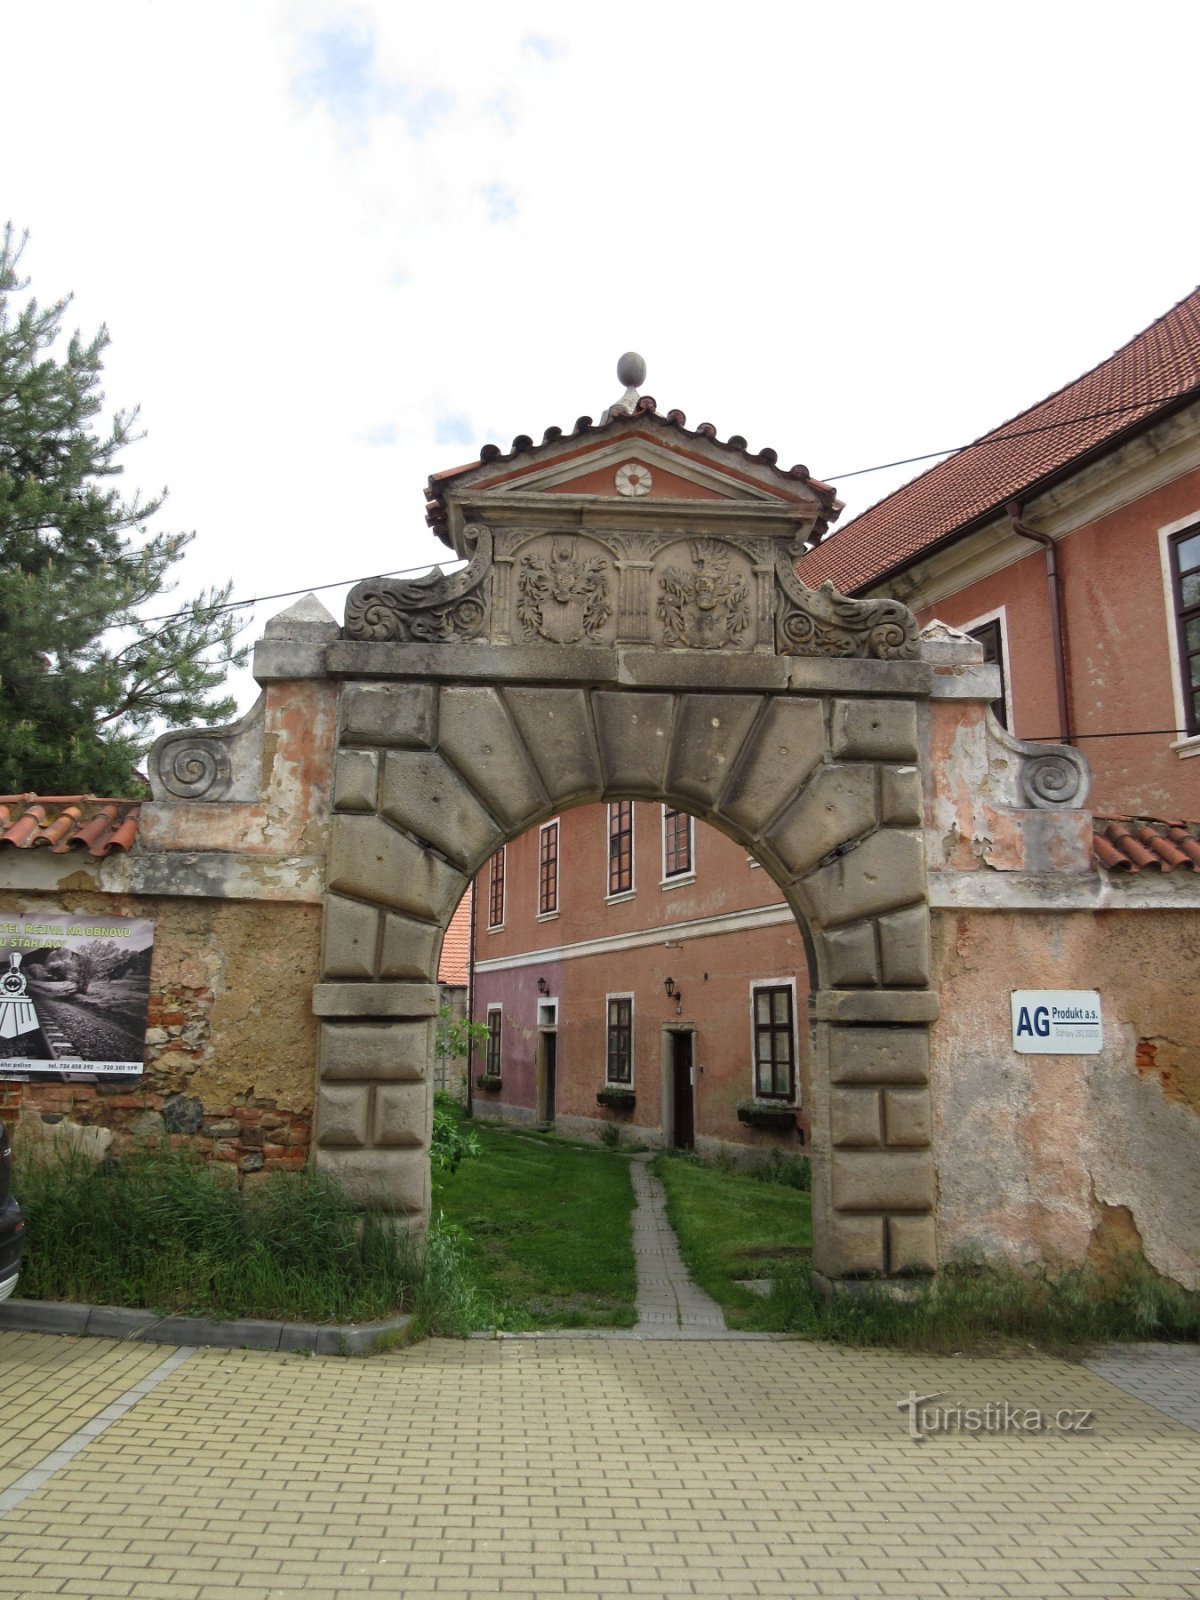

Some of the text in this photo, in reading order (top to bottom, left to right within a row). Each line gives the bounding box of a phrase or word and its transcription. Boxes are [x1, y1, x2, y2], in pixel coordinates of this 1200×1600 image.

[67, 926, 82, 936] NA
[86, 927, 132, 938] OBNOVU
[1016, 1006, 1050, 1037] AG
[1052, 1007, 1084, 1019] Produkt
[1085, 1010, 1098, 1019] a.s.
